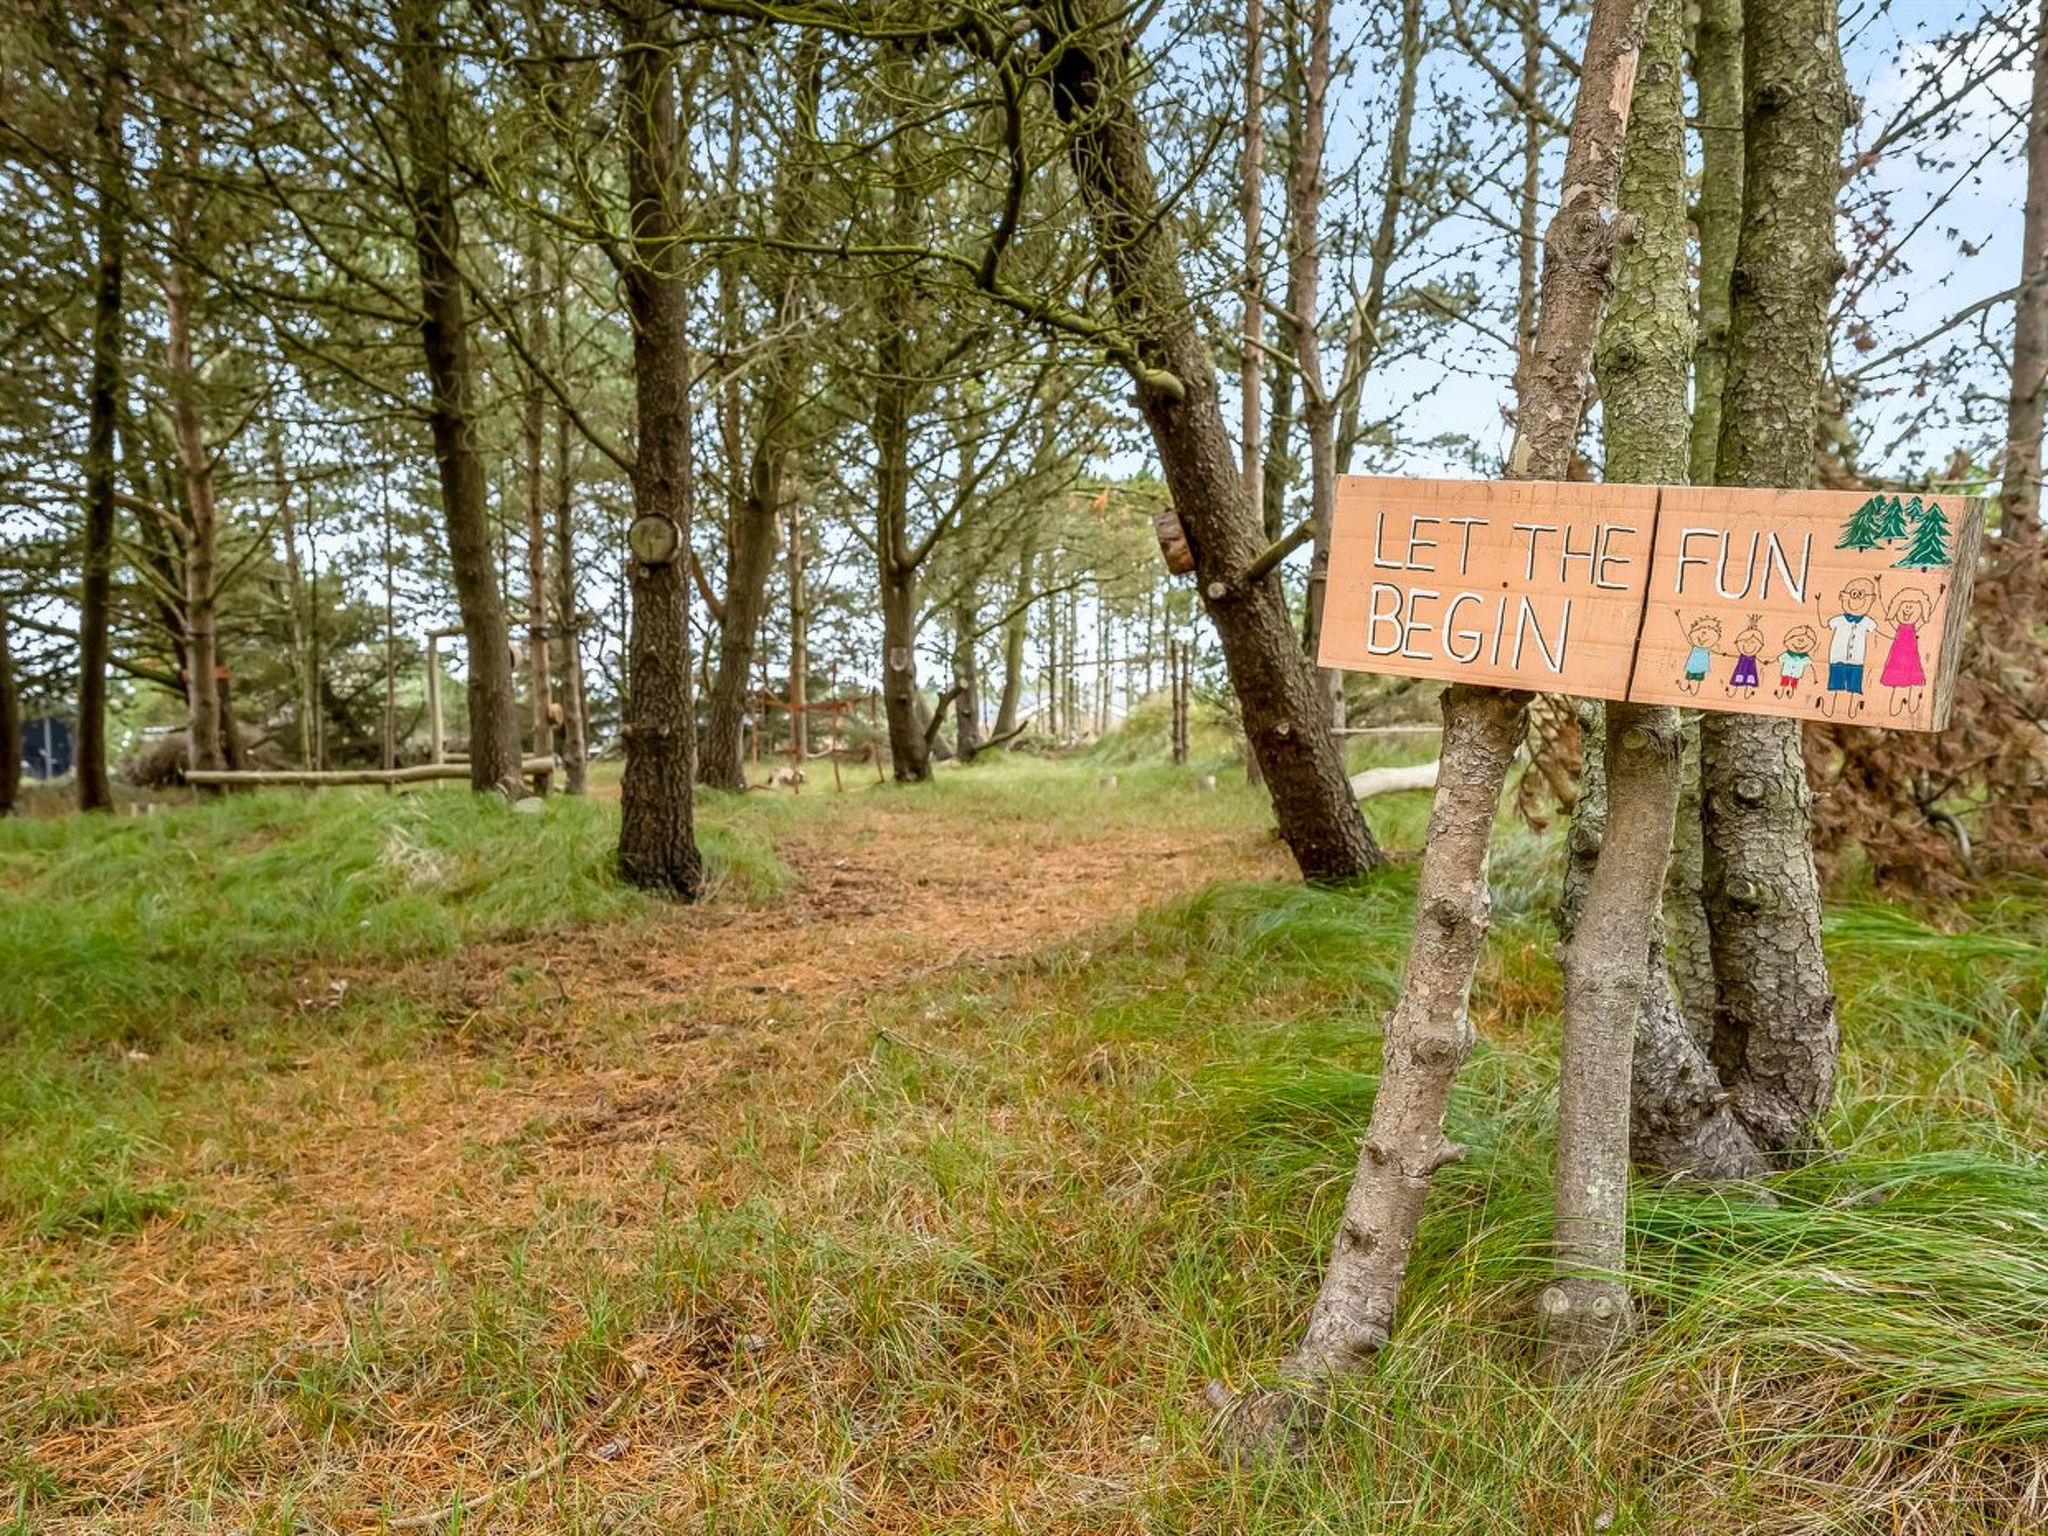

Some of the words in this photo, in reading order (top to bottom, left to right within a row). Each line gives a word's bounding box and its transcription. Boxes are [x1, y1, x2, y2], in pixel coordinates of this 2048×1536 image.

[1373, 512, 1489, 575] LET
[1513, 523, 1637, 590] THE
[1675, 527, 1811, 604] FUN
[1367, 583, 1571, 674] BEGIN
